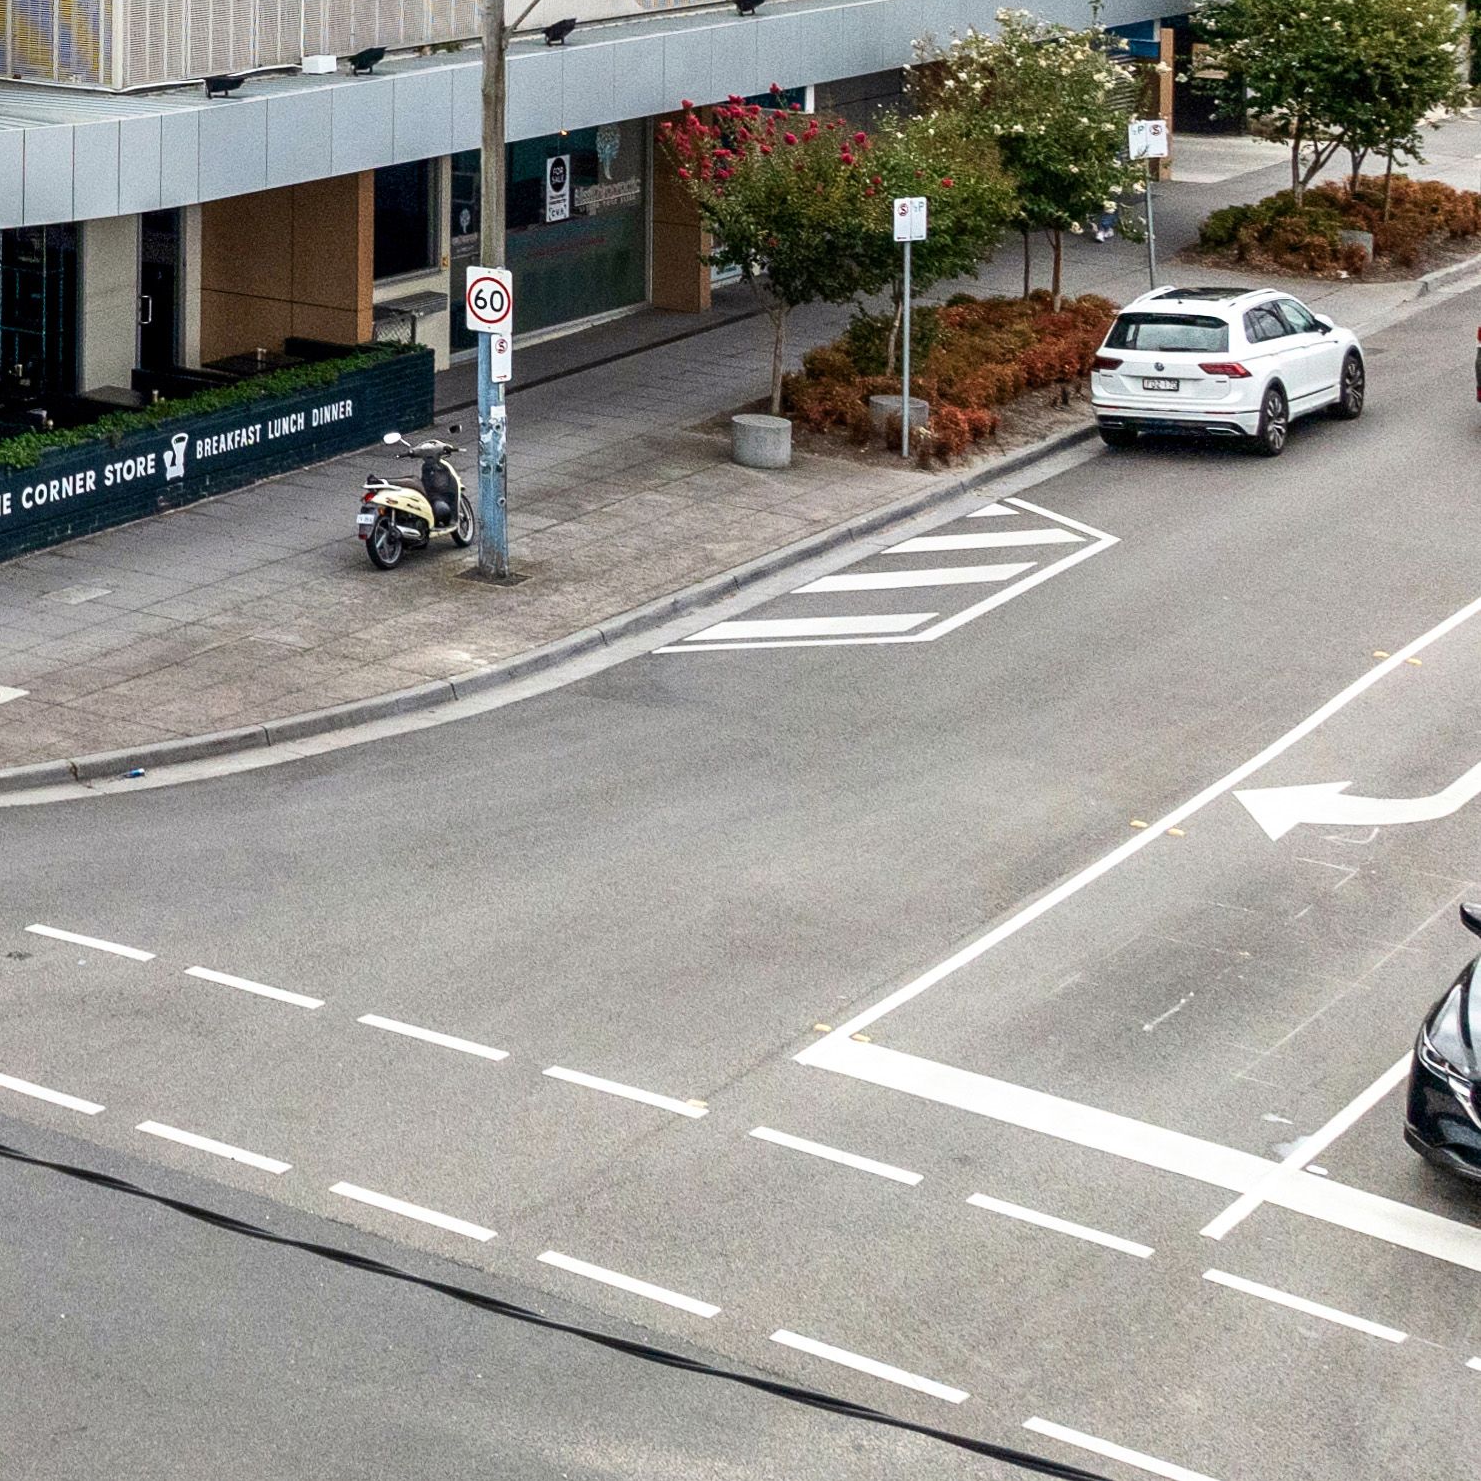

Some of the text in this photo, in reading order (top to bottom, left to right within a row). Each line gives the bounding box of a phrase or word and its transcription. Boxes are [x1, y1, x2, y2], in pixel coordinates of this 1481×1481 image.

[551, 175, 565, 185] SALE
[552, 166, 564, 175] FOR
[474, 288, 505, 313] 60
[196, 399, 353, 459] BREAKFAST LUNCH DINNER
[21, 470, 96, 509] CORNER
[104, 453, 156, 486] STORE
